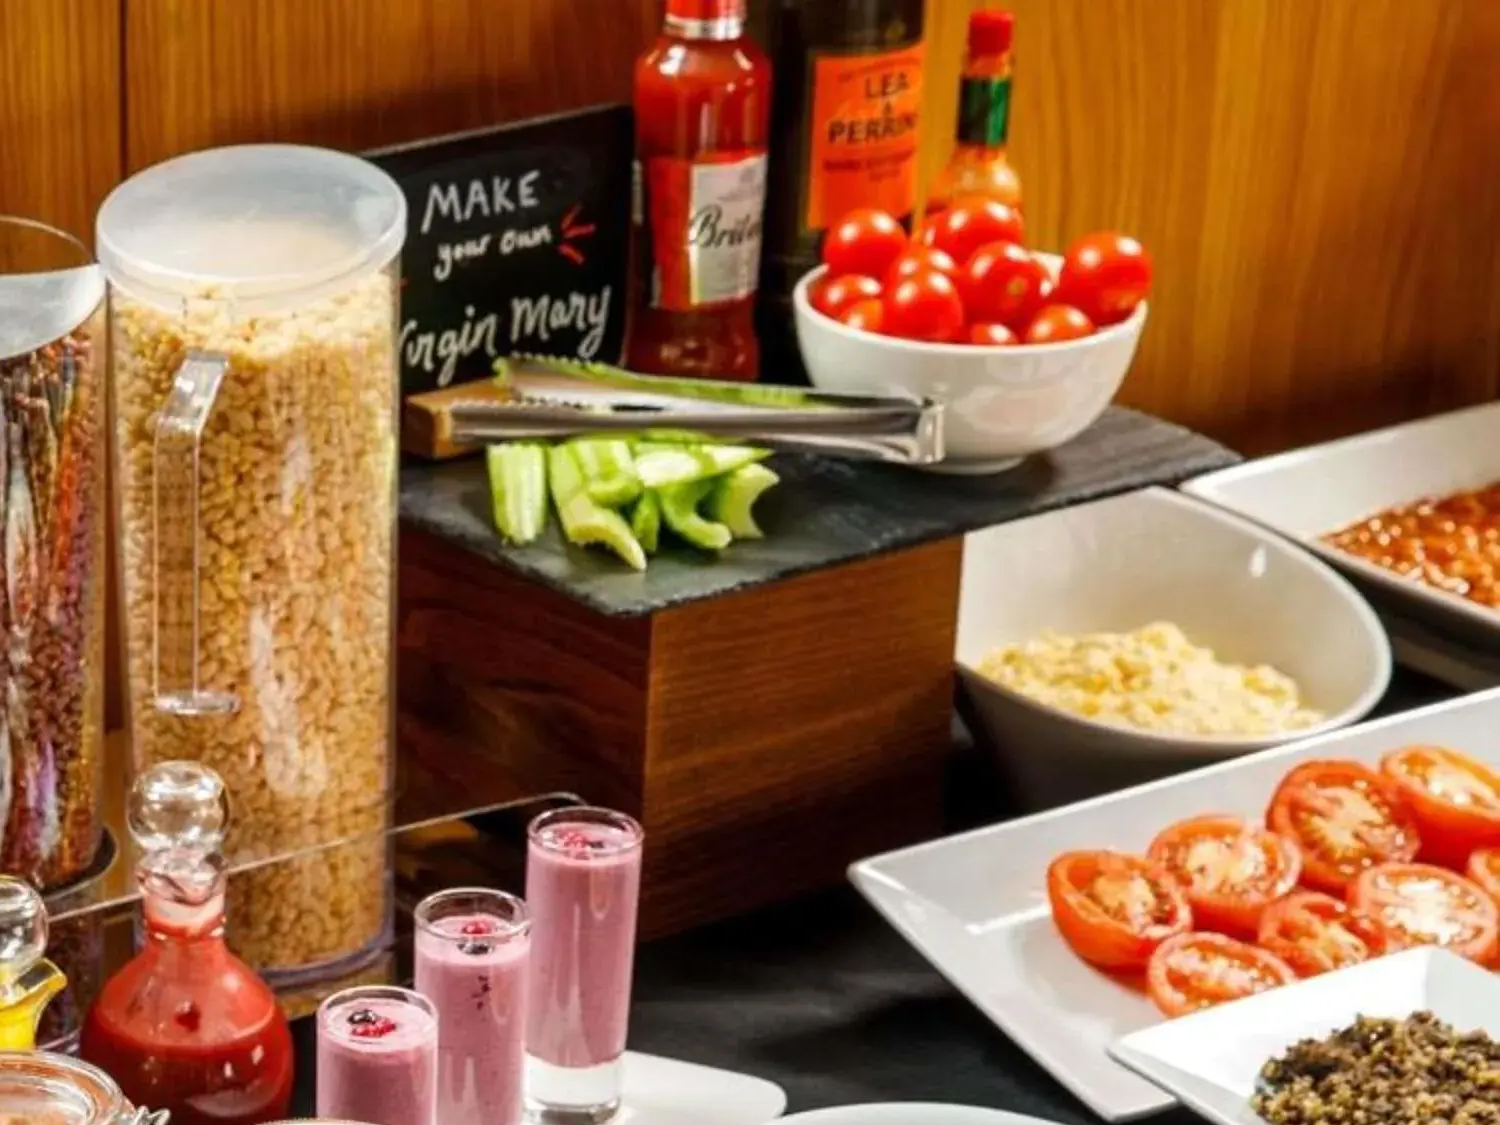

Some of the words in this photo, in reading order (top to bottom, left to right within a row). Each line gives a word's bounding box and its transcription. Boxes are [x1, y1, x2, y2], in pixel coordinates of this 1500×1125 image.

[864, 72, 909, 99] LEA
[420, 168, 541, 235] MAKE
[433, 233, 493, 282] your
[499, 223, 553, 255] own
[510, 285, 612, 360] Mary
